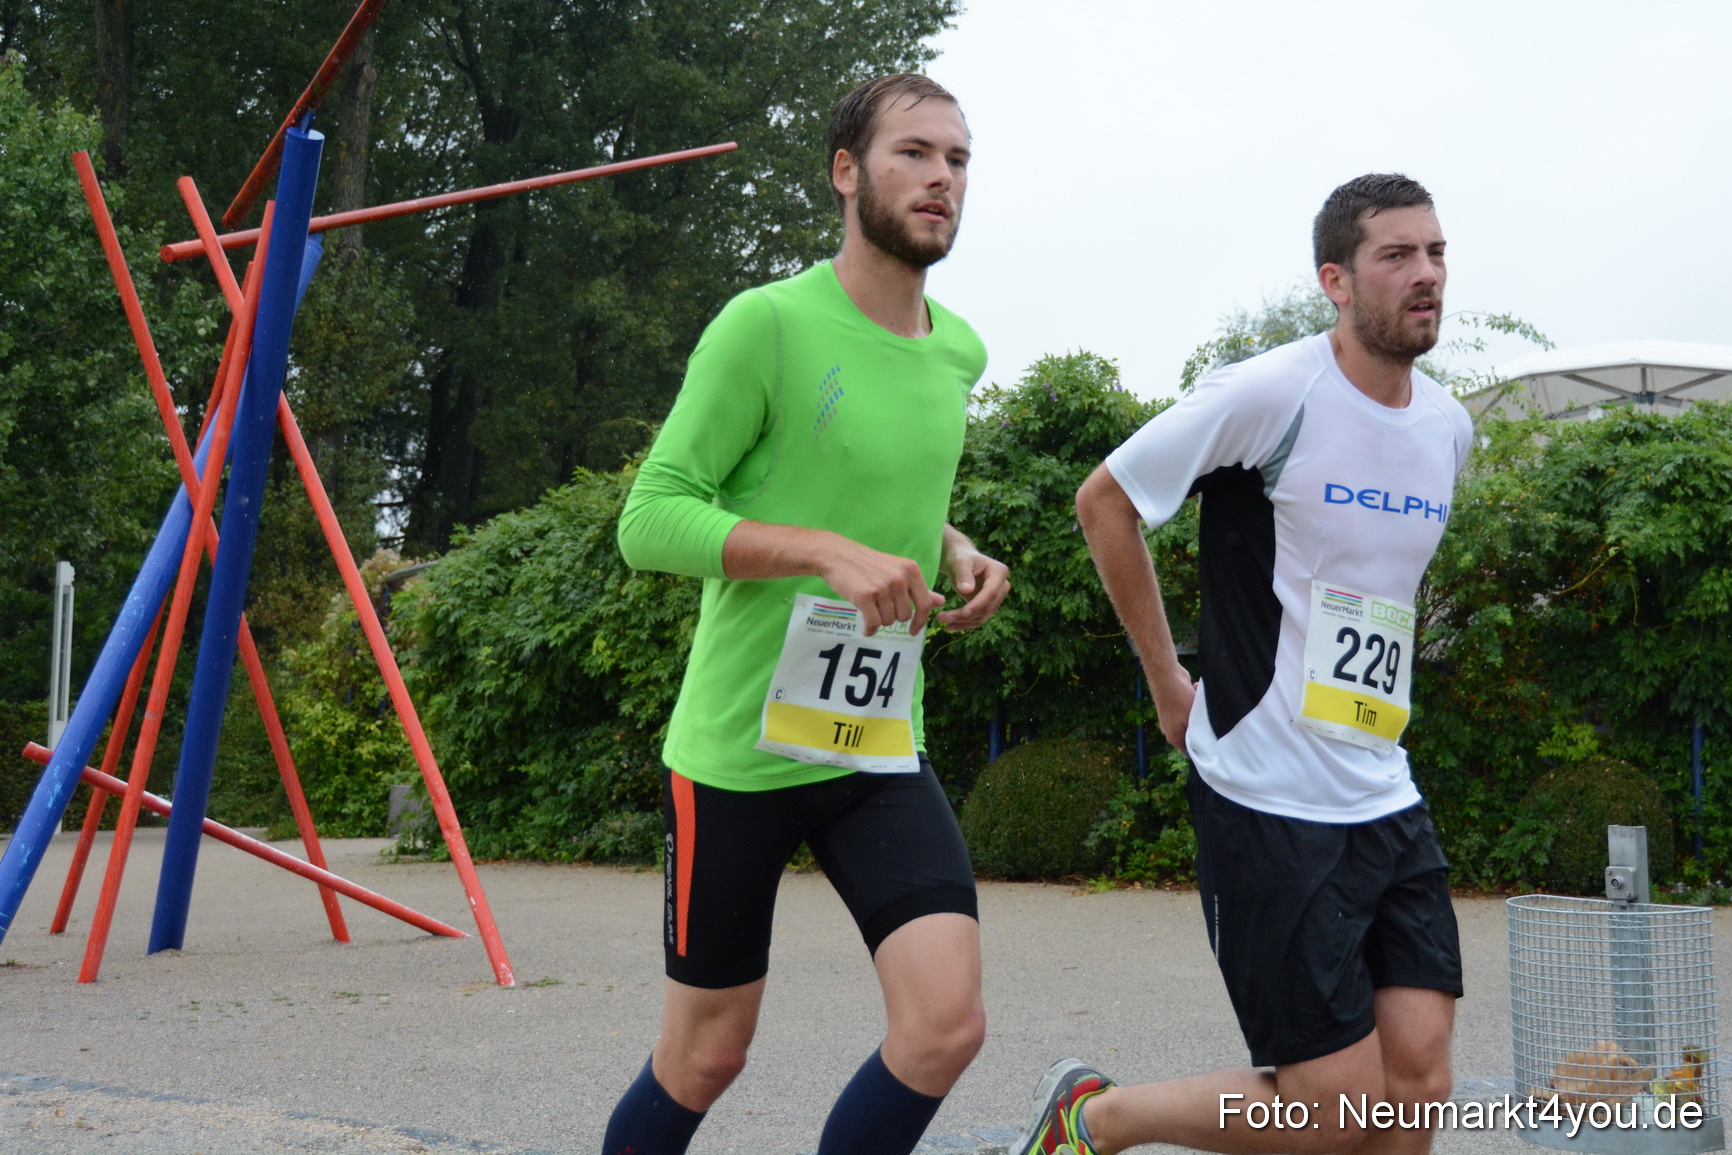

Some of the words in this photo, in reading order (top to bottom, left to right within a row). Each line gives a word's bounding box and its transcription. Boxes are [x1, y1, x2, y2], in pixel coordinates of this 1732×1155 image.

[1324, 483, 1447, 523] DELPHI
[1321, 600, 1363, 617] NeuerMarkt
[806, 616, 856, 631] NeuerMarkt
[1332, 626, 1401, 695] 229
[818, 643, 901, 708] 154
[1354, 700, 1377, 727] Tim
[833, 721, 864, 748] Till
